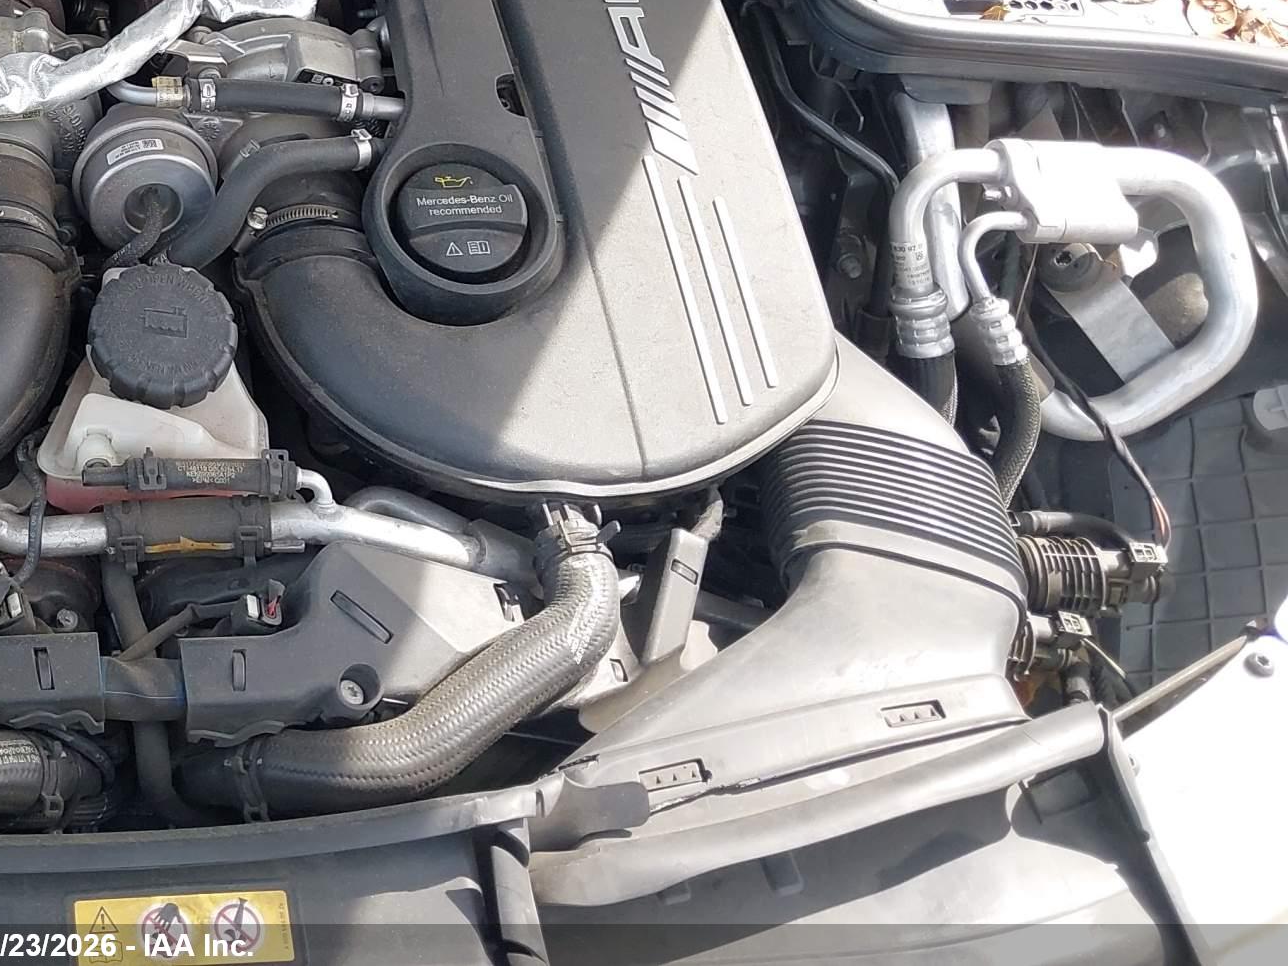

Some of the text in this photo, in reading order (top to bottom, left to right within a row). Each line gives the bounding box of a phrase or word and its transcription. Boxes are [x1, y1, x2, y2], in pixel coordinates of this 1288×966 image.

[416, 193, 514, 207] Mercedes-Benz Oil
[428, 205, 503, 216] recommended
